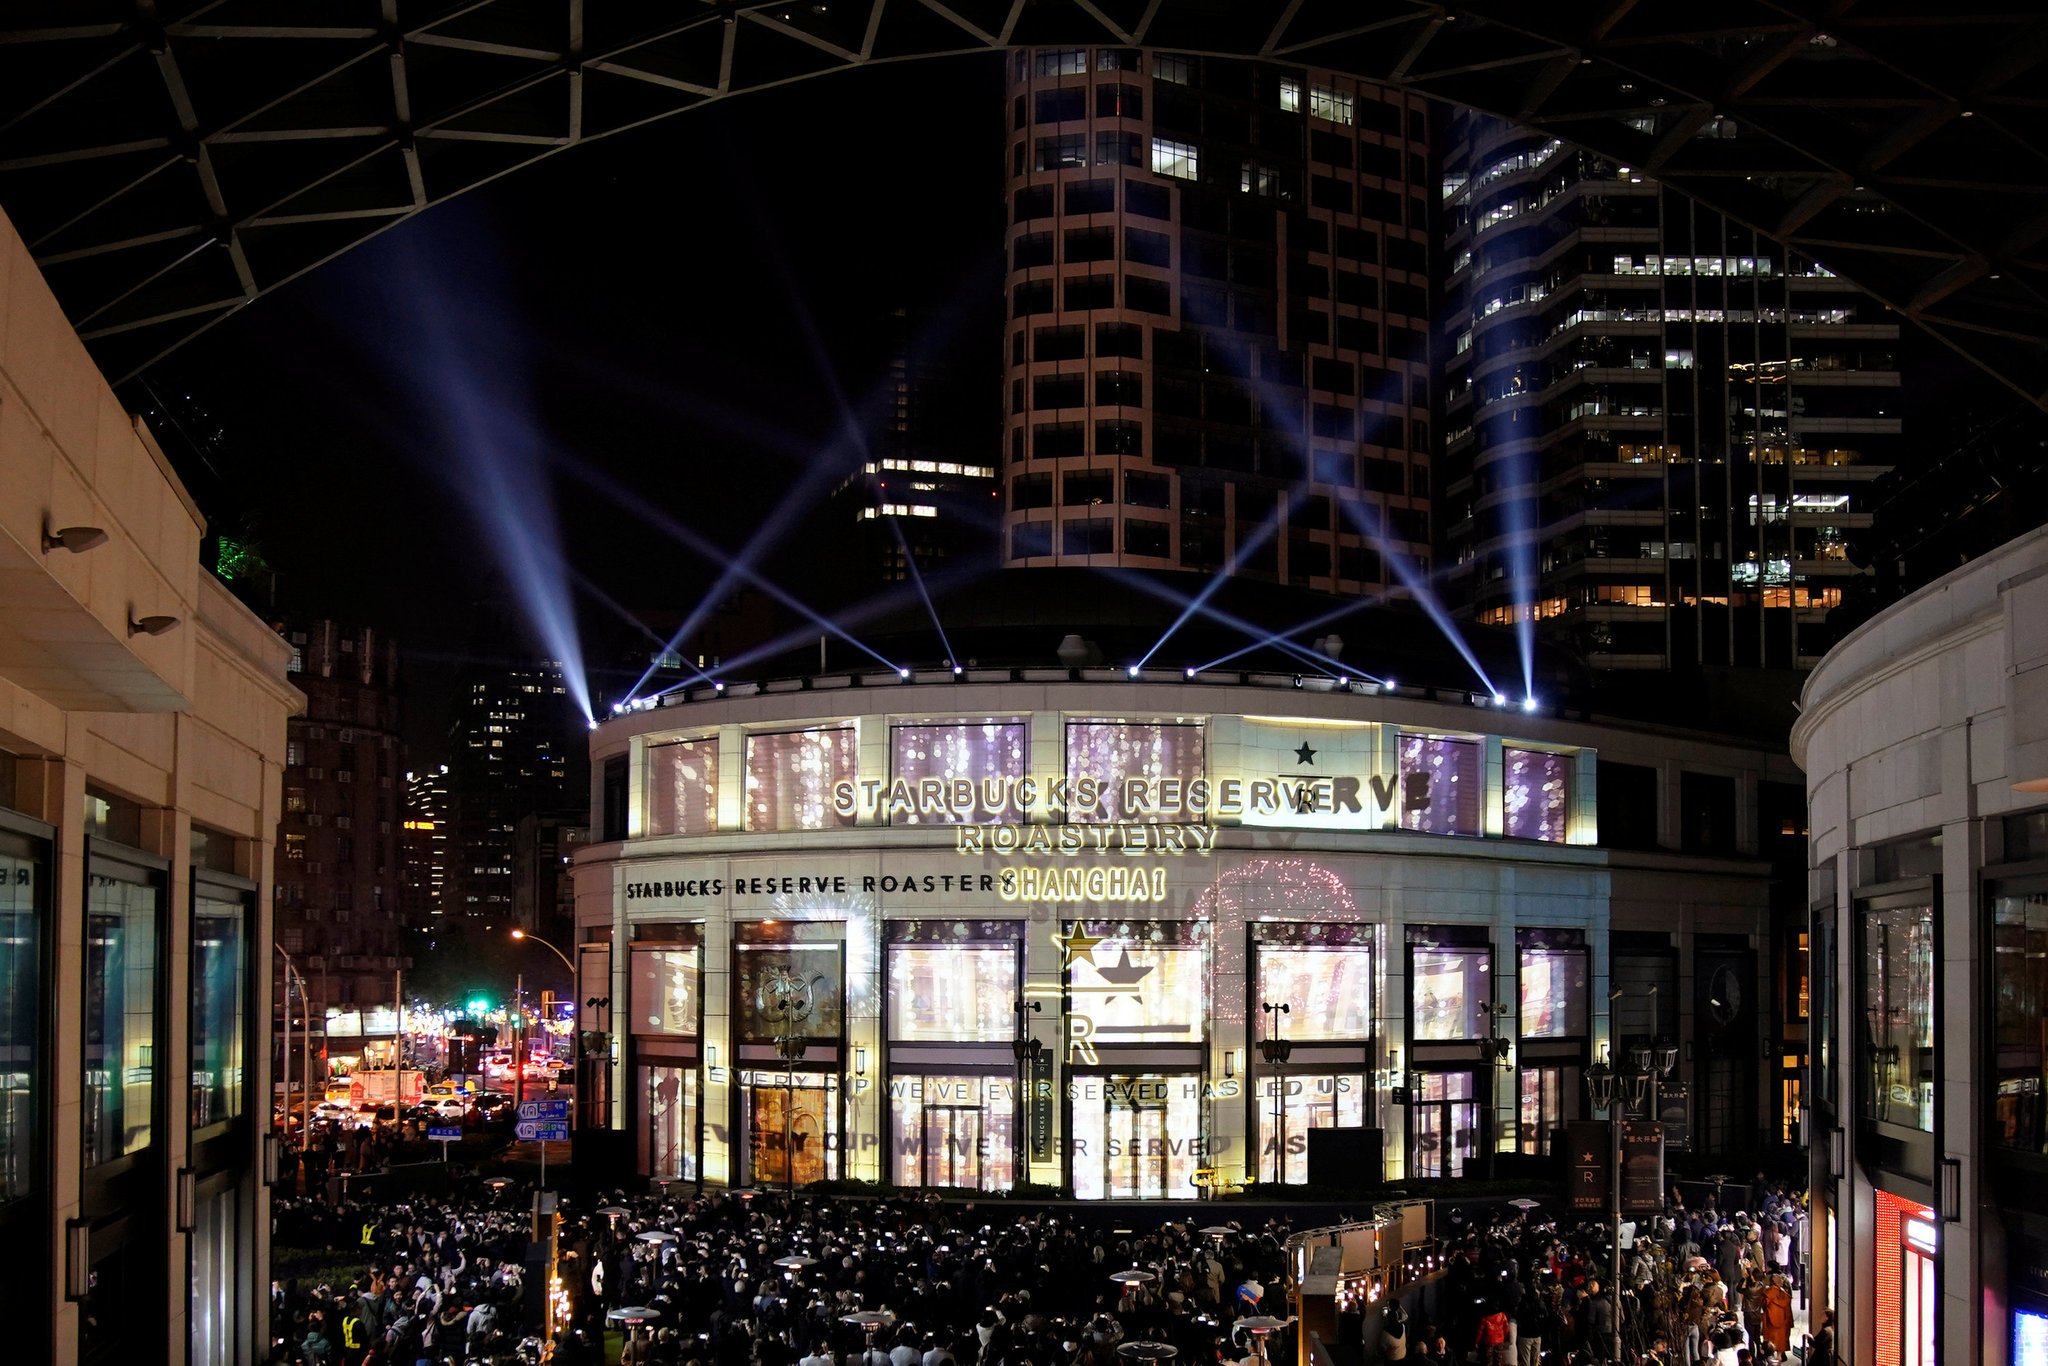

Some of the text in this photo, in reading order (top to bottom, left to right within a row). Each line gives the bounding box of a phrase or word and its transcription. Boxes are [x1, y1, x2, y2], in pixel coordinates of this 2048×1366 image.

[834, 777, 1098, 814] STARBUCKS
[1126, 778, 1332, 814] RESERVE
[958, 824, 1217, 854] ROASTERY
[626, 873, 1015, 900] STARBUCKS RESERVE ROASTERY
[1000, 867, 1166, 900] SHANGHAI
[1065, 1011, 1099, 1066] R
[882, 1082, 968, 1100] WE'VE
[1068, 1083, 1169, 1100] SERVED
[1183, 1080, 1239, 1098] HAS
[1317, 1077, 1351, 1095] US
[1583, 1171, 1594, 1183] R
